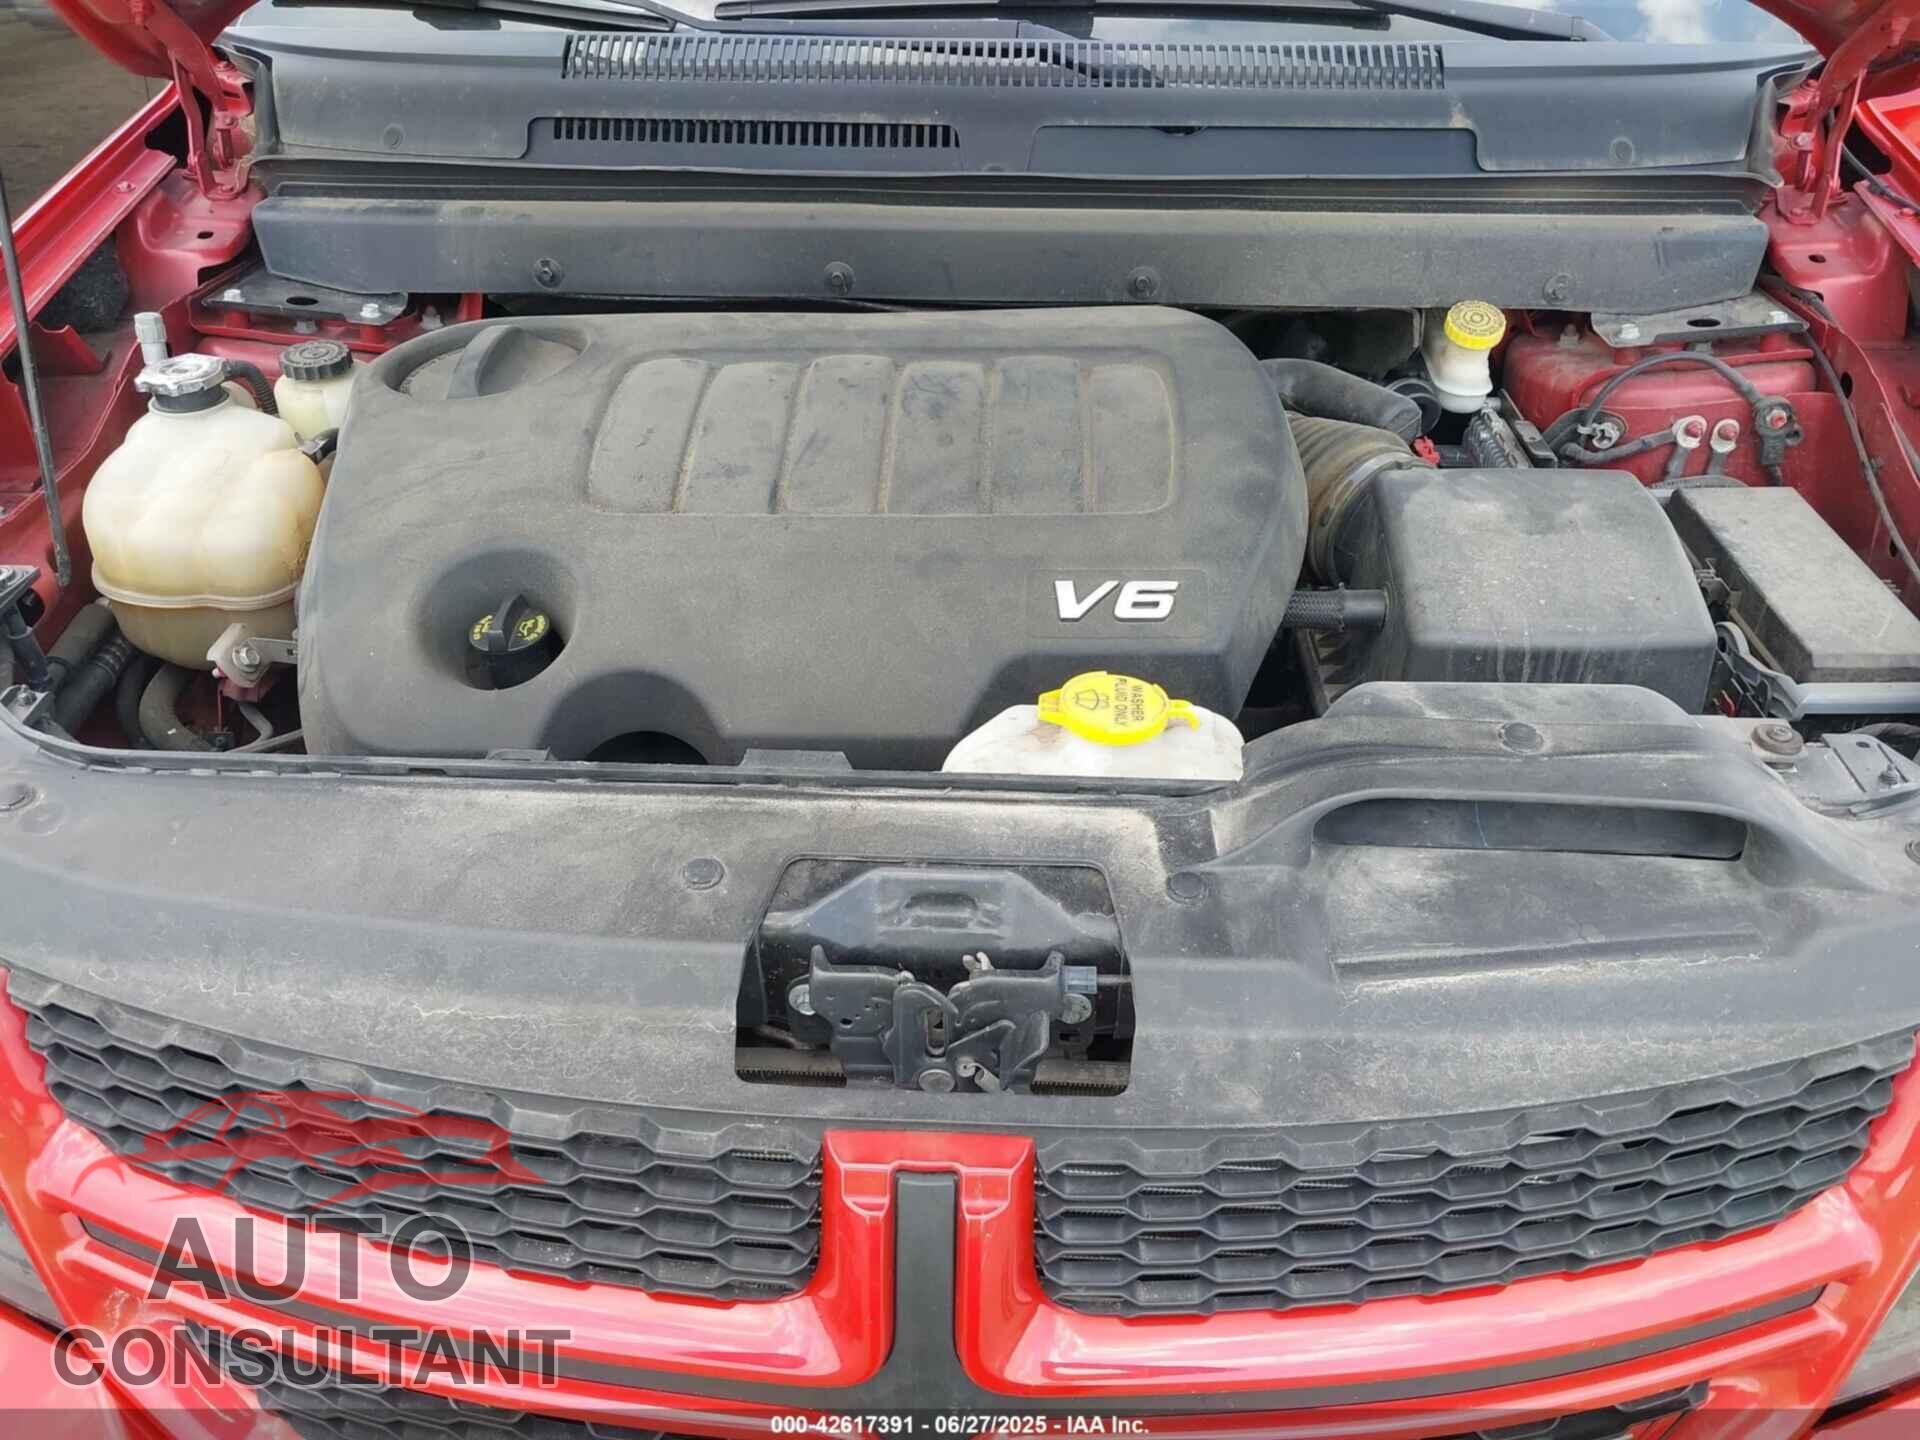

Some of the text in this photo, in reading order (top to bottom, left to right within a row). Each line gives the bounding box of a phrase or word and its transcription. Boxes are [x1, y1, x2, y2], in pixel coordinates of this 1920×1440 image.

[1054, 580, 1179, 622] V6
[1115, 678, 1128, 727] FLUID ONLY
[1131, 685, 1145, 721] WASHER
